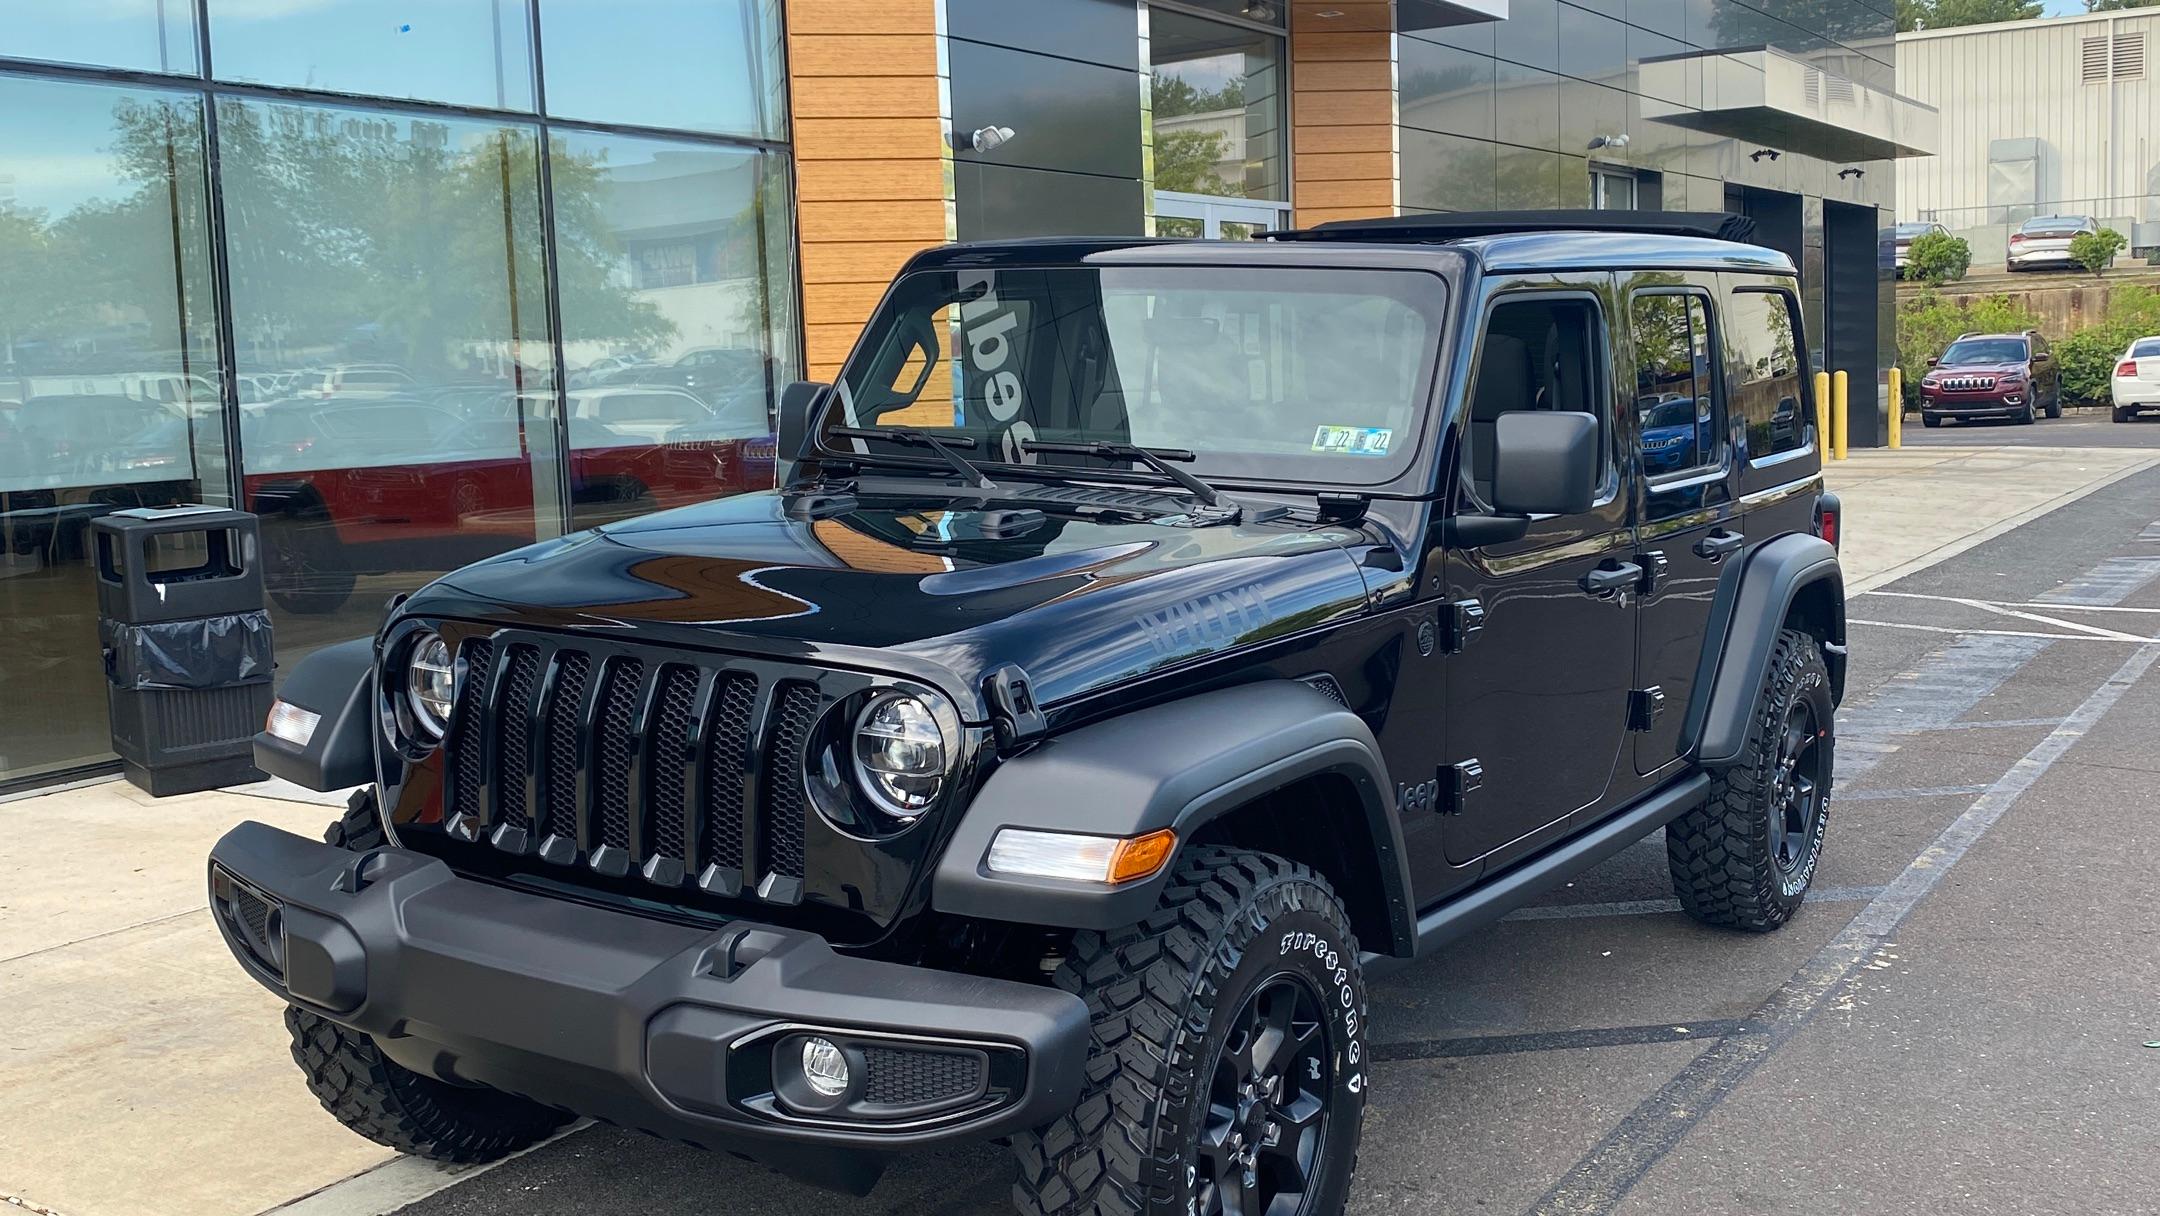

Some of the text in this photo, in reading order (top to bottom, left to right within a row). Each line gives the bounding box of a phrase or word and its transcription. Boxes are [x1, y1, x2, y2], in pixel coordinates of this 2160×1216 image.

[1336, 430, 1350, 448] 22
[1373, 432, 1388, 450] 22
[1134, 583, 1273, 653] WILLYS
[1396, 779, 1438, 812] Jeep
[1279, 931, 1361, 1065] Firestone
